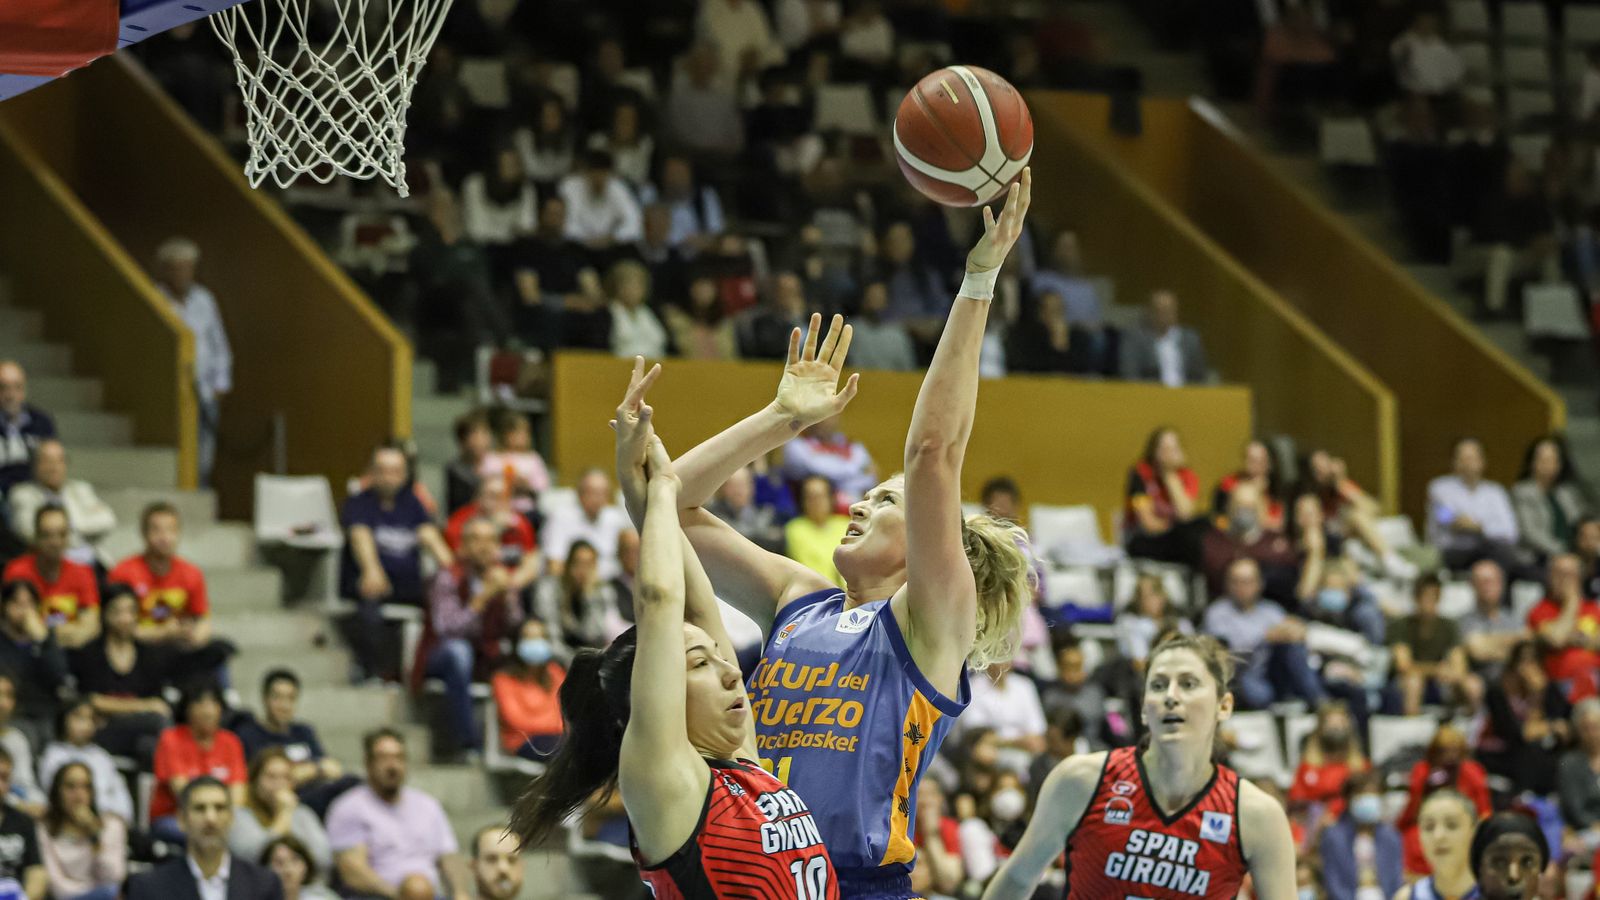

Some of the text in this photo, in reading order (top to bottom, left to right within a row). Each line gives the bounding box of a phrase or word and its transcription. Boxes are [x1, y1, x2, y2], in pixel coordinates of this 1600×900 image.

[837, 672, 870, 691] del
[760, 814, 824, 855] GION
[1126, 829, 1200, 866] SPAR
[789, 855, 827, 900] 10
[1104, 851, 1210, 896] GIRONA
